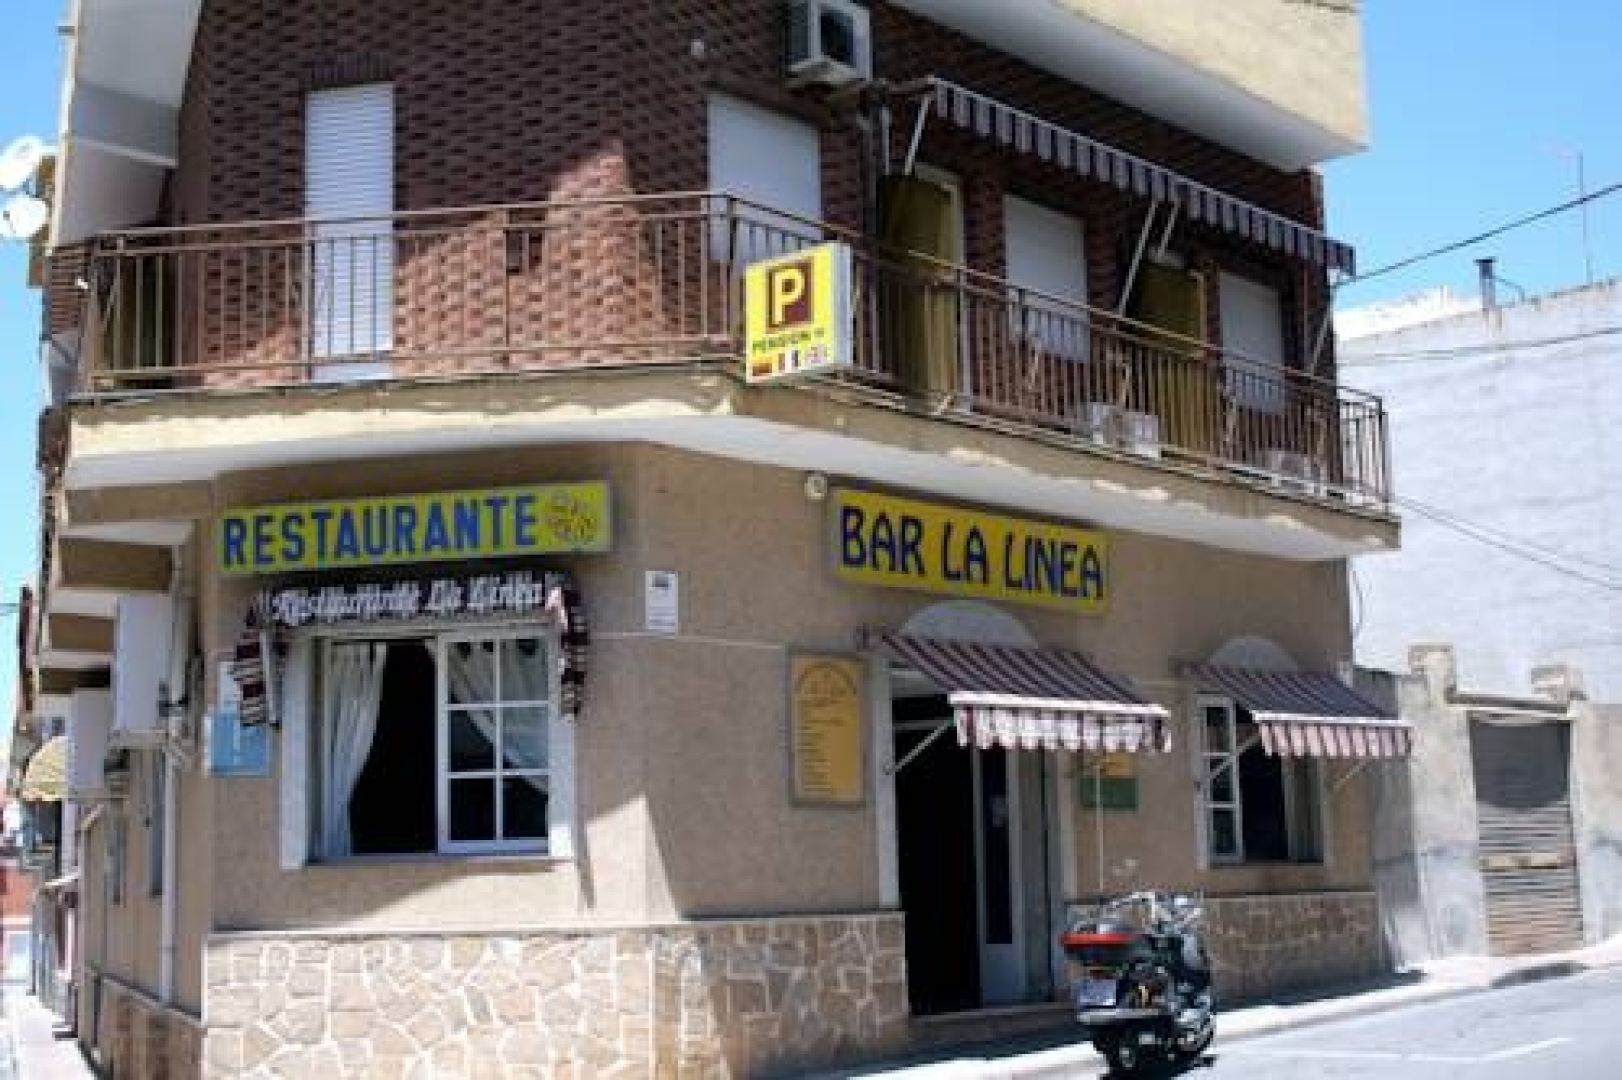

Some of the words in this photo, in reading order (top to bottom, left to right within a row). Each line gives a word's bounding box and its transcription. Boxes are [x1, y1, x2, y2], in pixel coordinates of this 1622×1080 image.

[773, 267, 806, 325] P
[222, 494, 536, 567] RESTAURANTE
[841, 506, 925, 577] BAR
[942, 522, 990, 584] LA
[1005, 531, 1104, 598] LINEA
